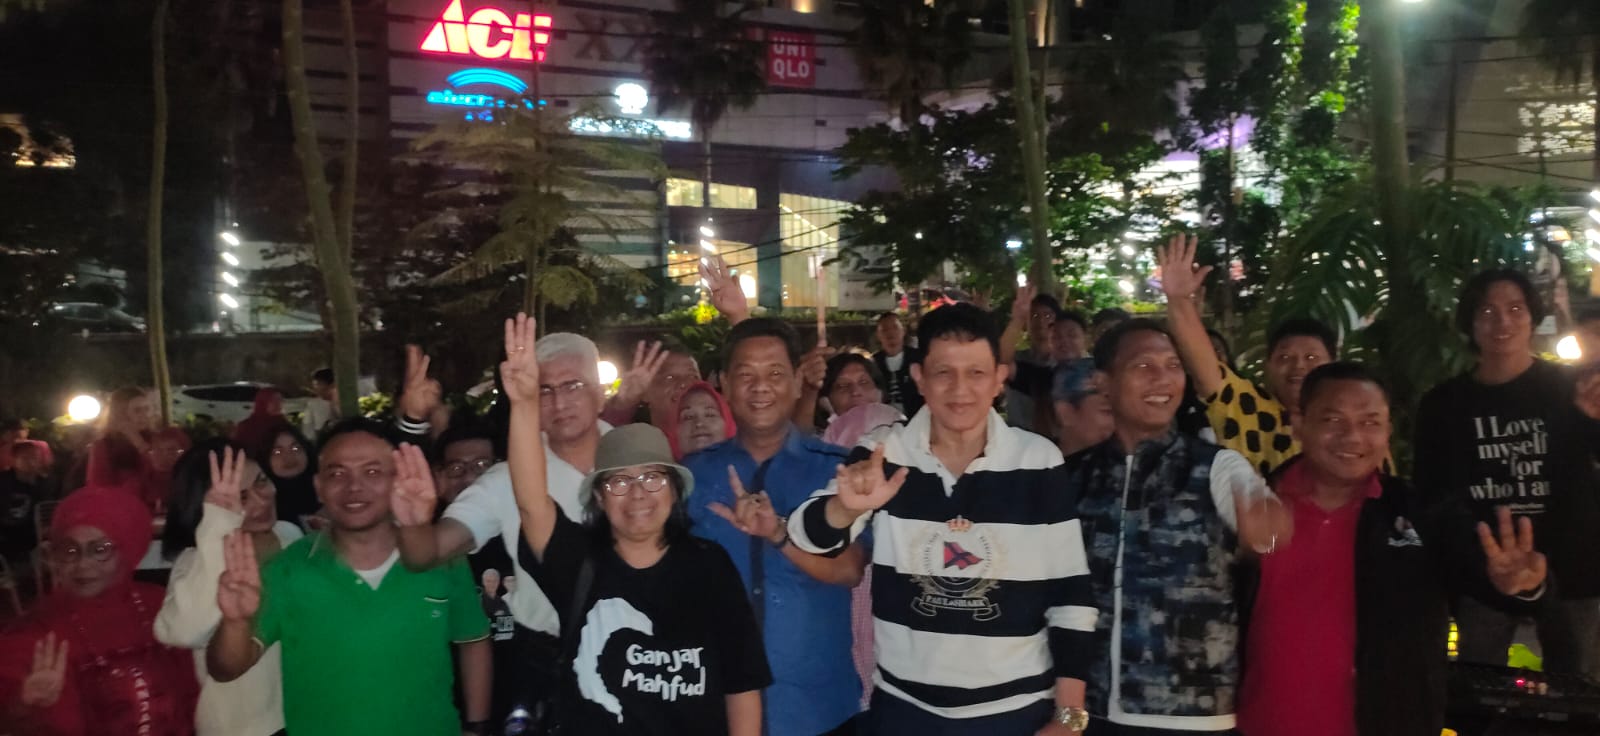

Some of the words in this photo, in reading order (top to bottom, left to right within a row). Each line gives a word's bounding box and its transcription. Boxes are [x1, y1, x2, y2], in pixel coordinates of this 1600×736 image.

[420, 0, 552, 60] ACE
[773, 36, 806, 57] UNI
[773, 59, 810, 79] QLO
[1473, 416, 1485, 439] I
[1488, 416, 1545, 438] Love
[1477, 431, 1549, 464] myself
[1509, 453, 1543, 477] for
[1469, 477, 1513, 500] who
[625, 643, 705, 673] Ganjar
[621, 665, 706, 702] Mahfud
